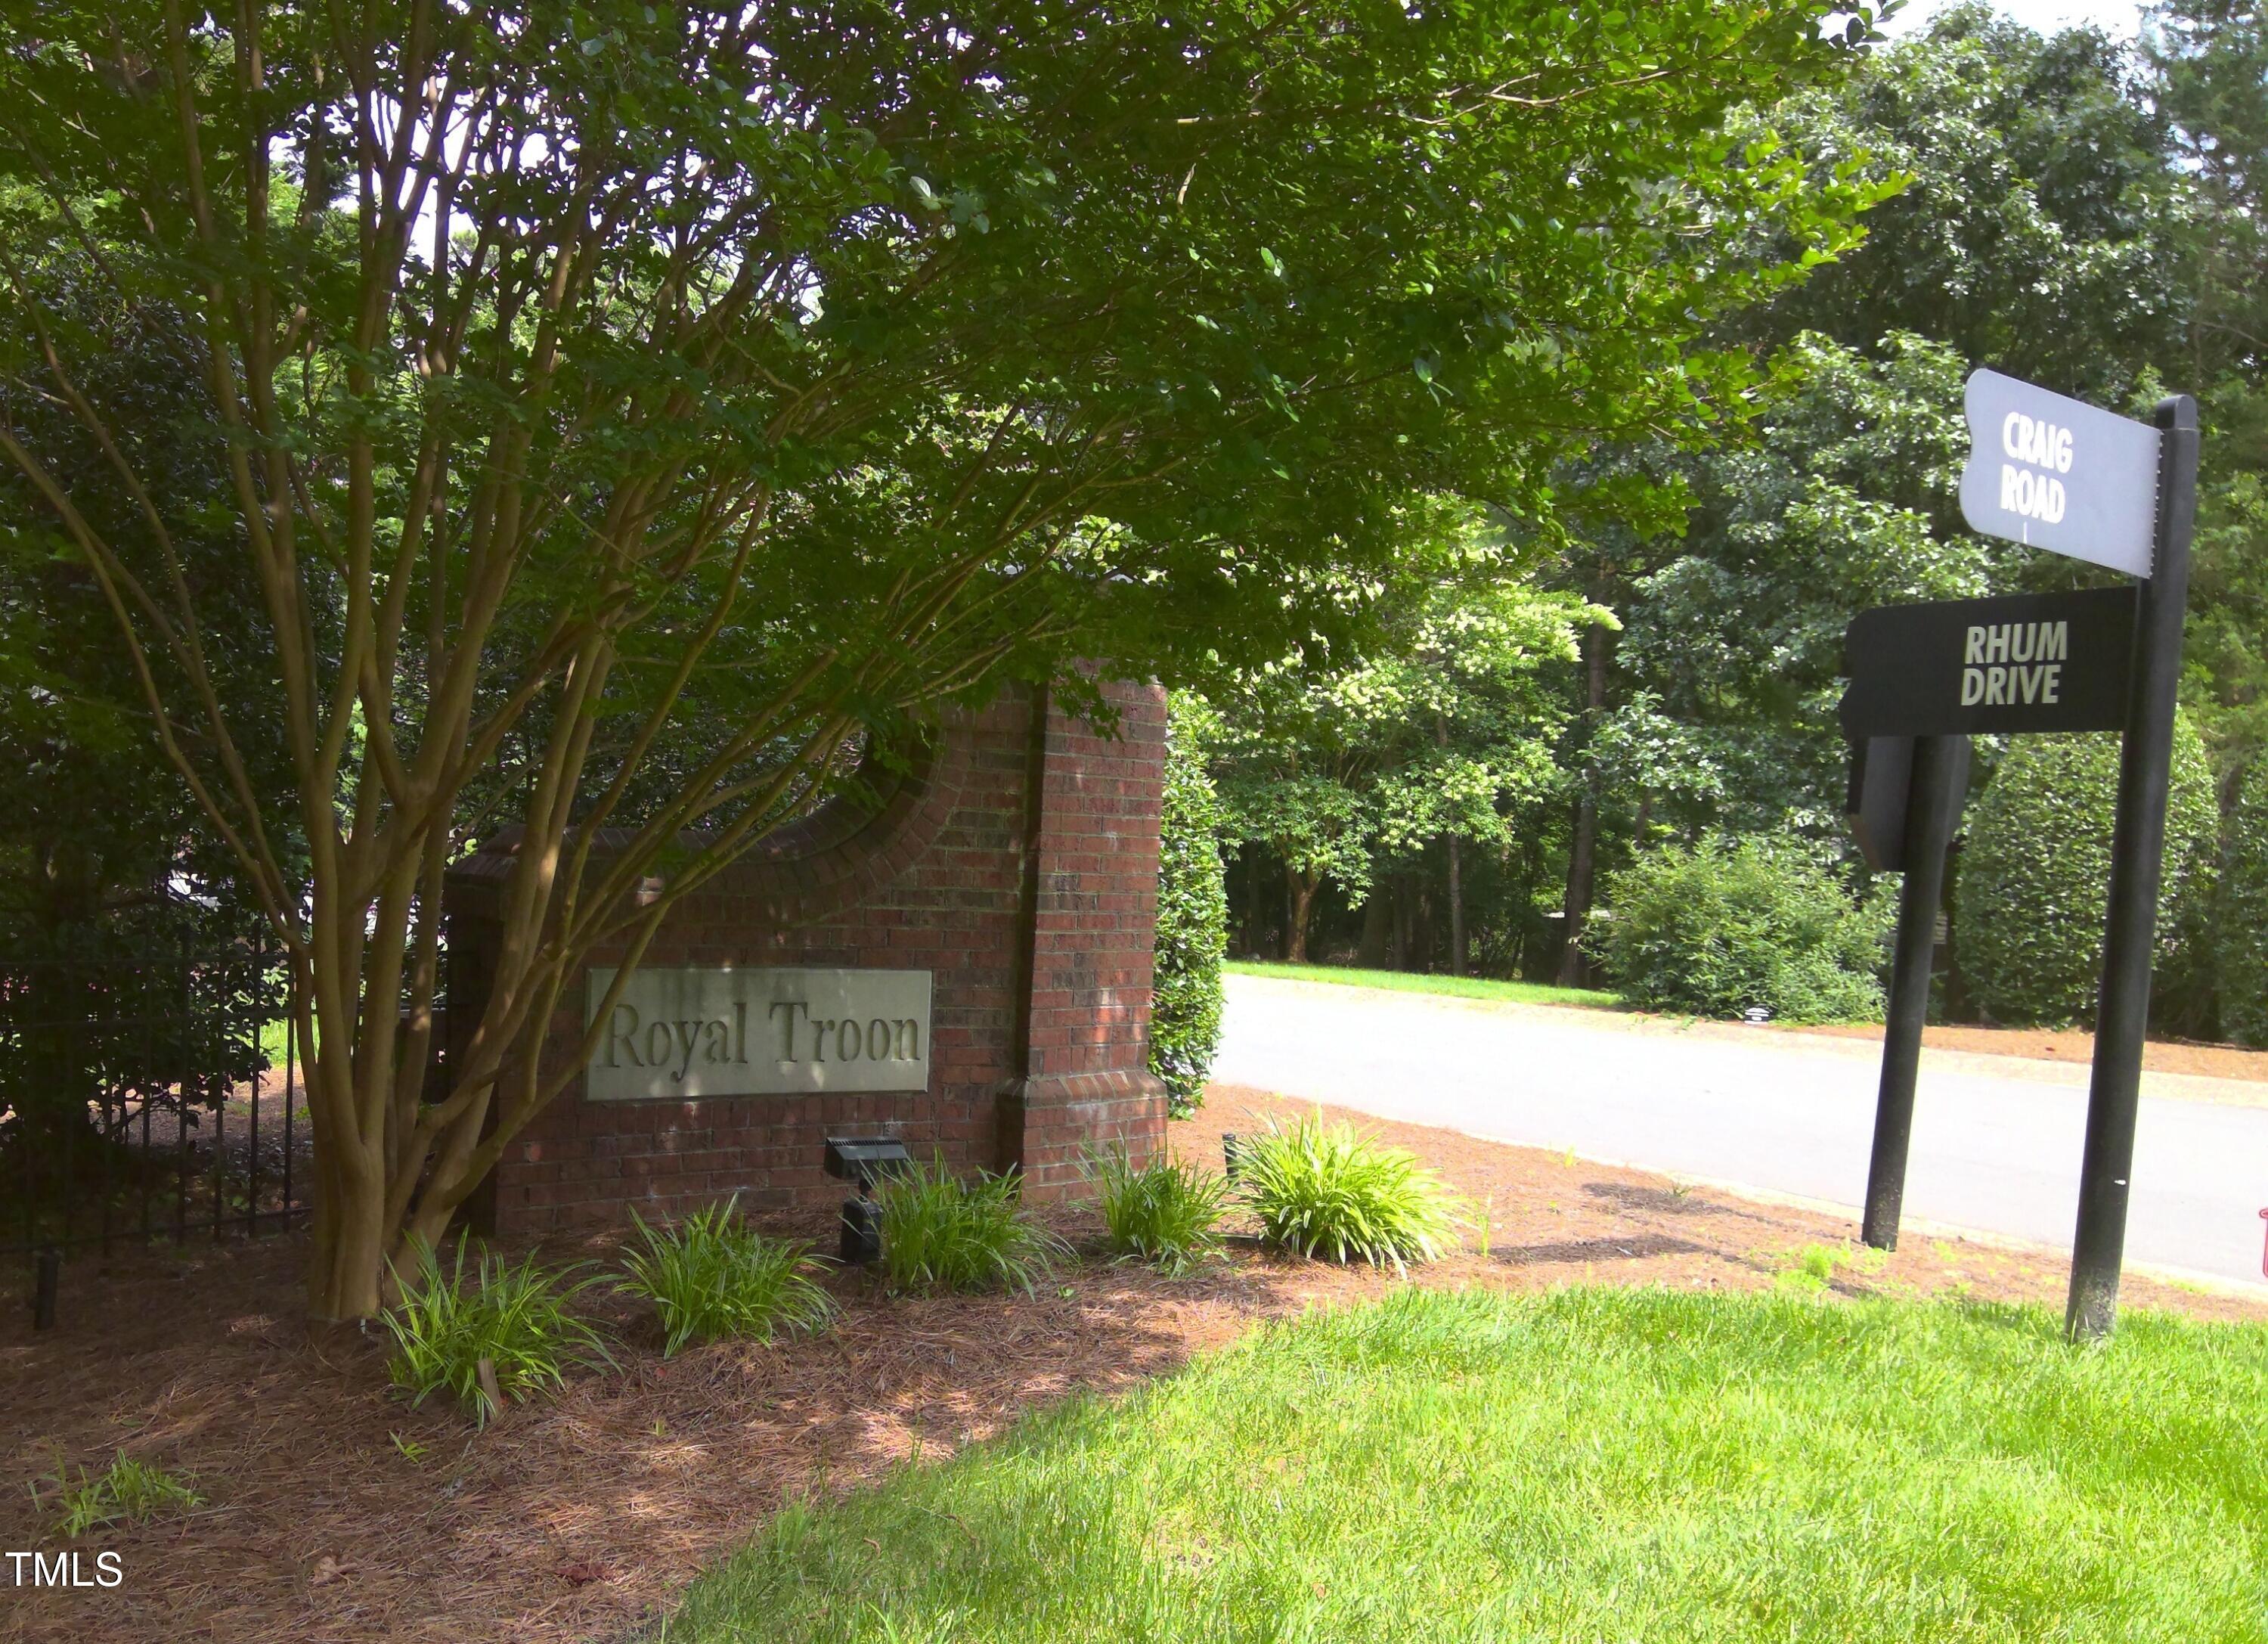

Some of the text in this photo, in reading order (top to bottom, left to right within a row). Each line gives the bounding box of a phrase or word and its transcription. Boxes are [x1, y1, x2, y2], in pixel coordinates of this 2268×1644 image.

[2003, 411, 2073, 474] CRAIG
[2000, 464, 2065, 523] ROAD
[1965, 621, 2068, 663] RHUM
[1961, 665, 2060, 706] DRIVE
[596, 1001, 920, 1083] Royal Troon
